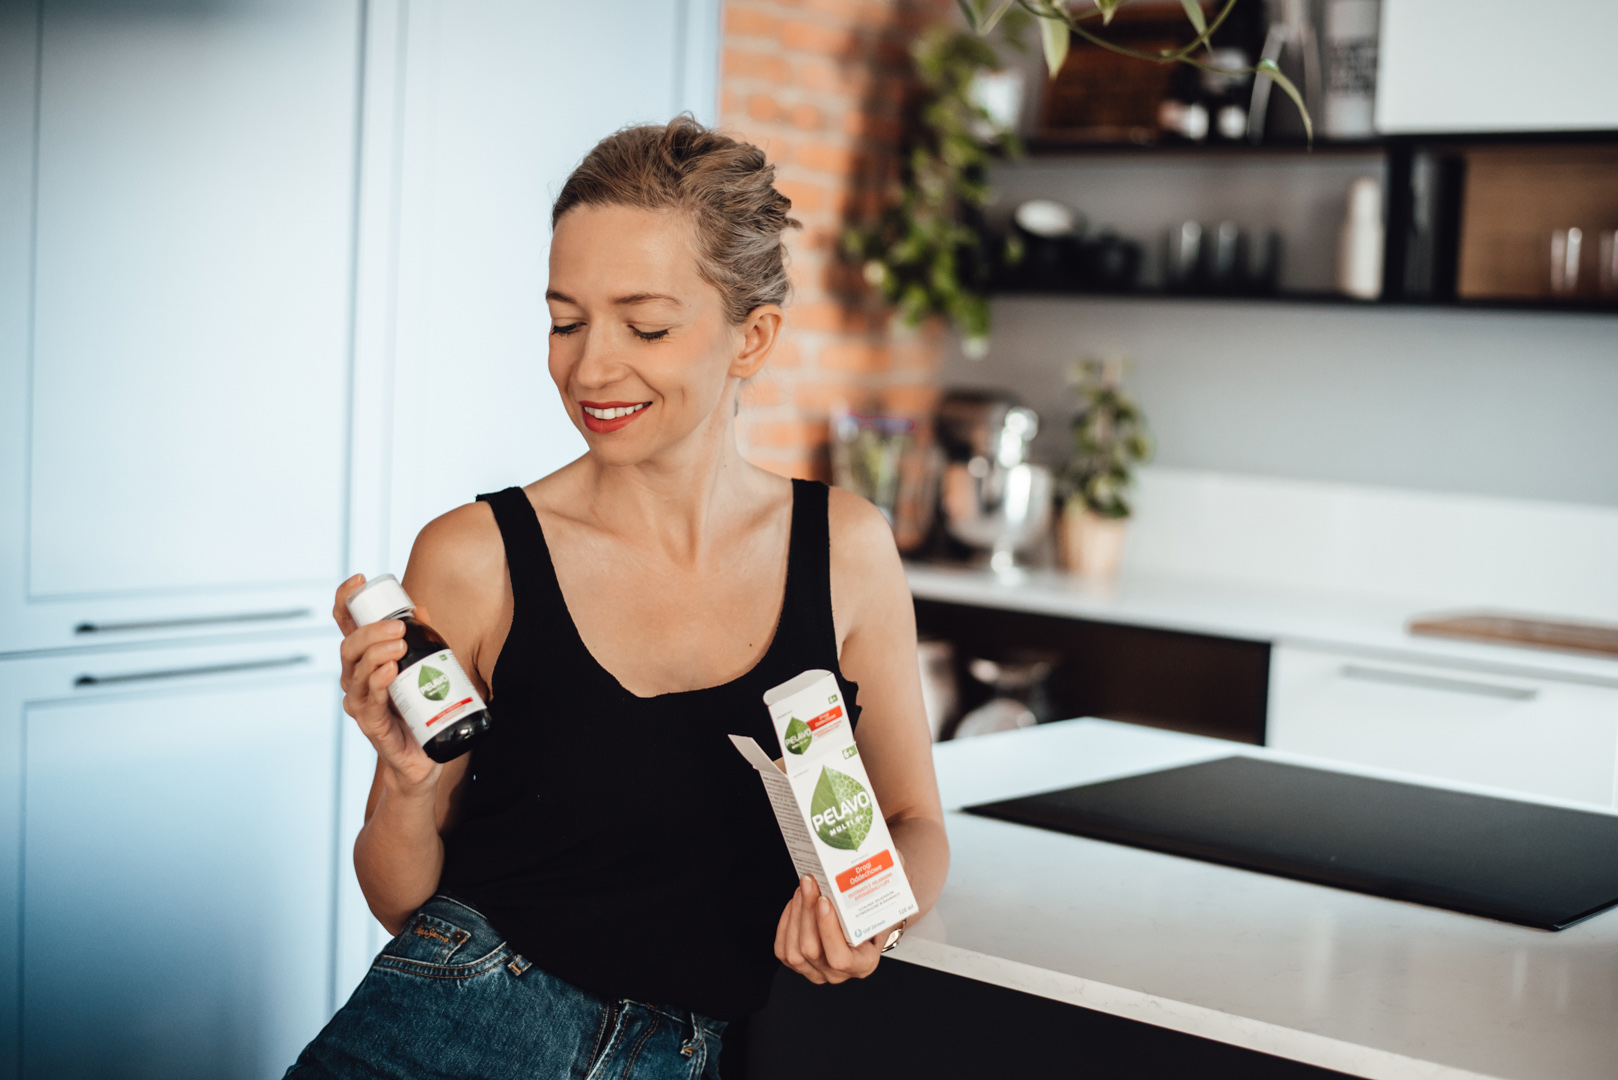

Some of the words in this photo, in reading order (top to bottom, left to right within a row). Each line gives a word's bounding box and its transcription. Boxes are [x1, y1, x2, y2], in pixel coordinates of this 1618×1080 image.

[785, 728, 812, 746] PELAVO
[843, 748, 854, 758] 6+
[812, 791, 870, 832] PELAVO
[829, 819, 854, 837] MULTI
[849, 864, 882, 885] Oddechowe
[855, 861, 872, 874] Drogi
